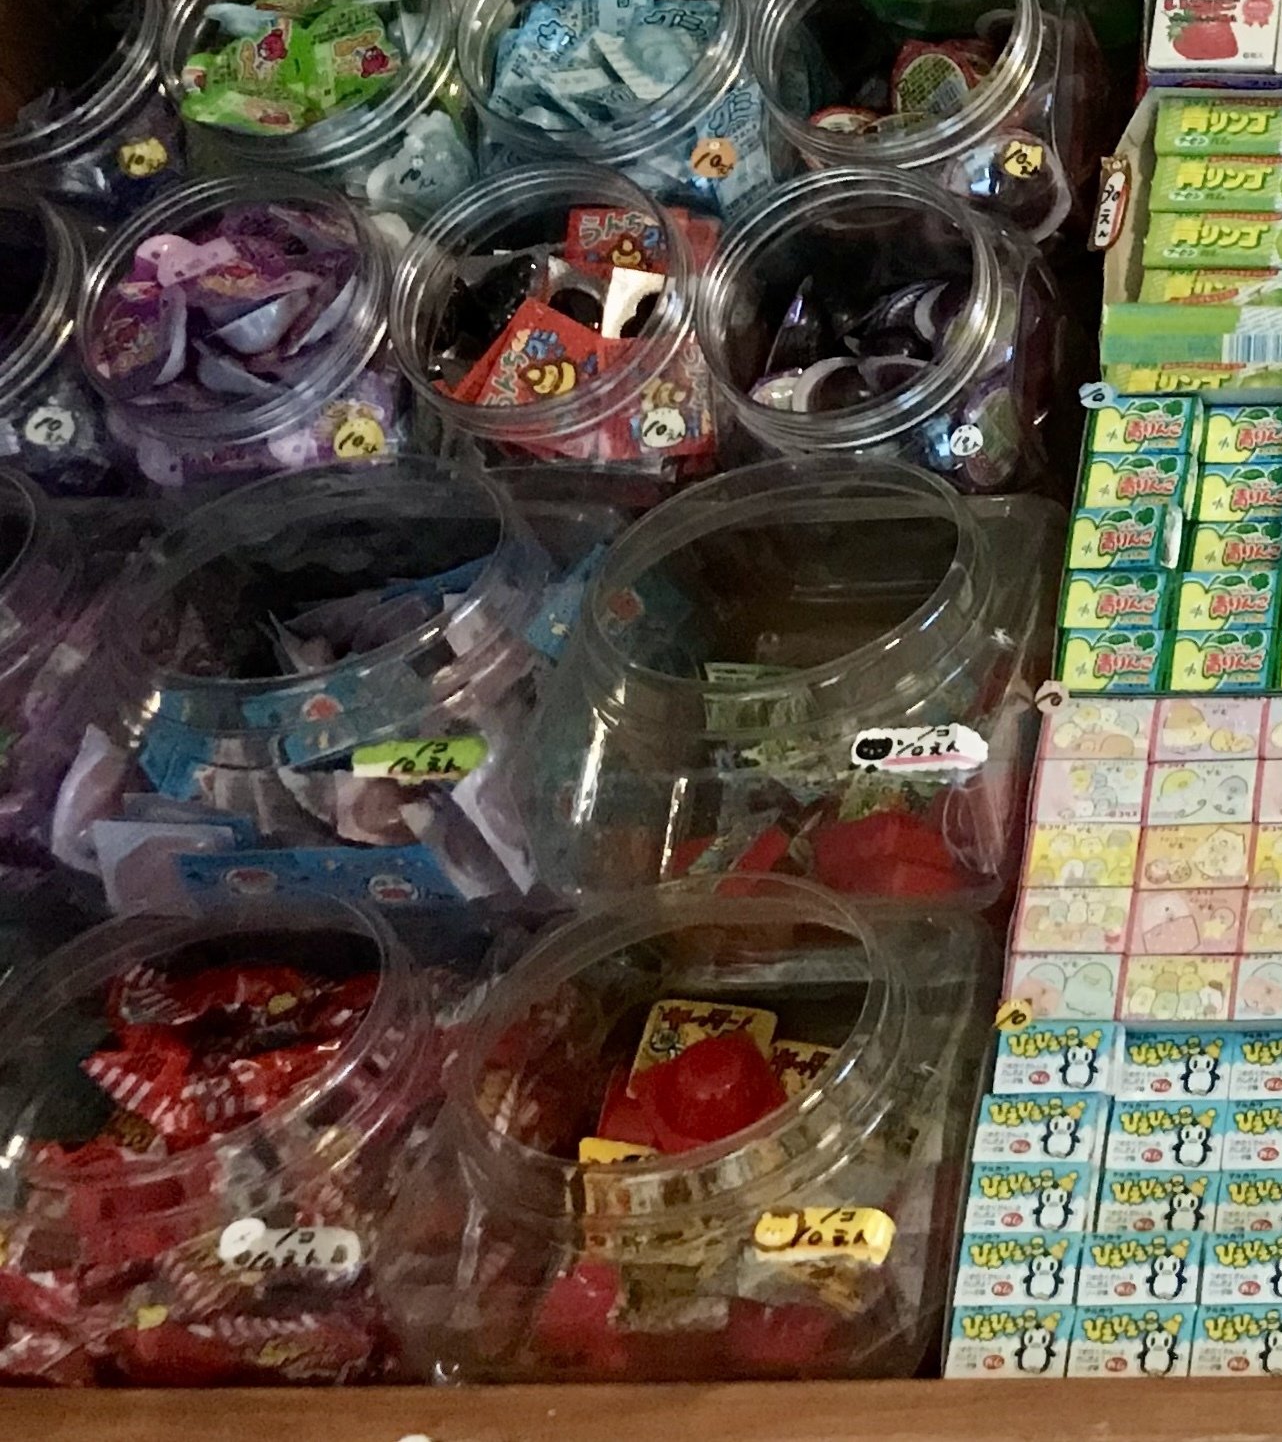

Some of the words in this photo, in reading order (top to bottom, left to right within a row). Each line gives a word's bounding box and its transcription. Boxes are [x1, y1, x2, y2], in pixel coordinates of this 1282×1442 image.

[1180, 111, 1277, 134] 青リンゴ
[1175, 166, 1273, 190] 青リンゴ
[1171, 222, 1269, 247] 青リンゴ
